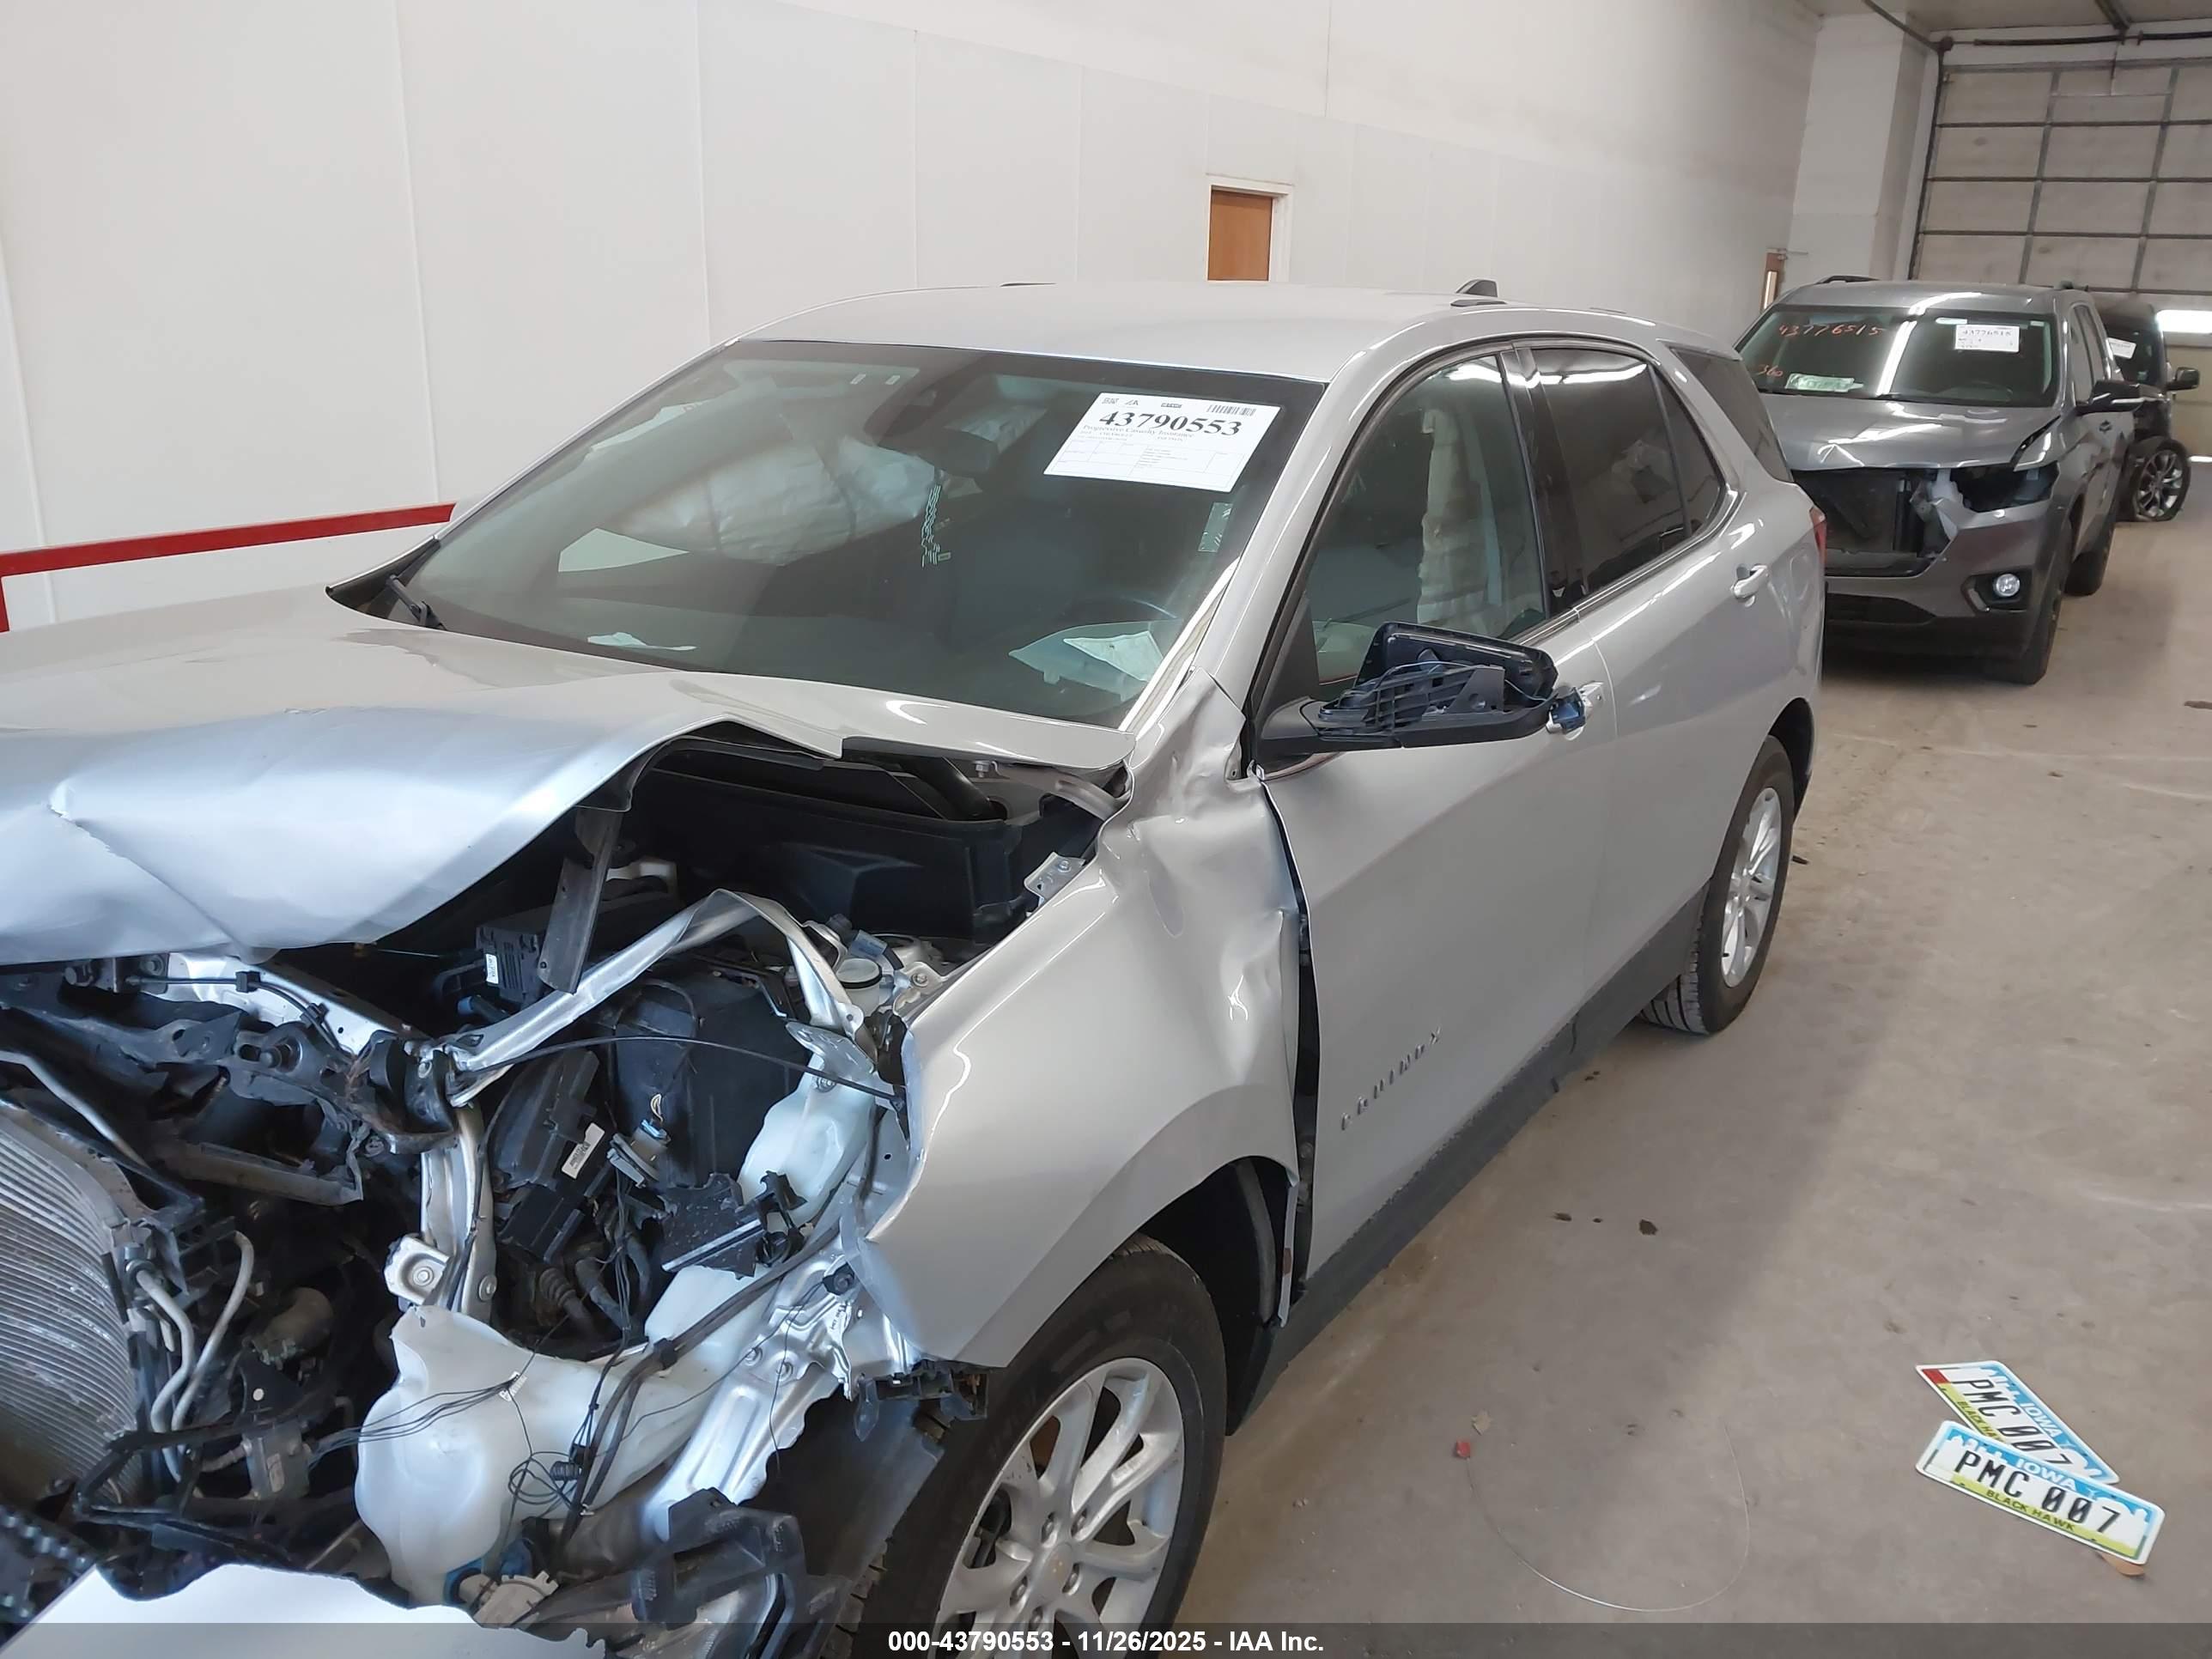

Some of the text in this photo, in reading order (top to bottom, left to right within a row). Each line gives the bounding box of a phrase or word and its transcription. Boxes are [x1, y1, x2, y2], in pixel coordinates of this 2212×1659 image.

[1779, 324, 1887, 337] 43776515
[1099, 410, 1243, 436] 43790553
[1952, 1379, 2074, 1465] PMC 007
[2020, 1401, 2063, 1438] IOWA
[1954, 1449, 2121, 1533] PMC 007
[2016, 1459, 2077, 1491] IOWA
[1986, 1488, 2075, 1531] BLACK HAWK
